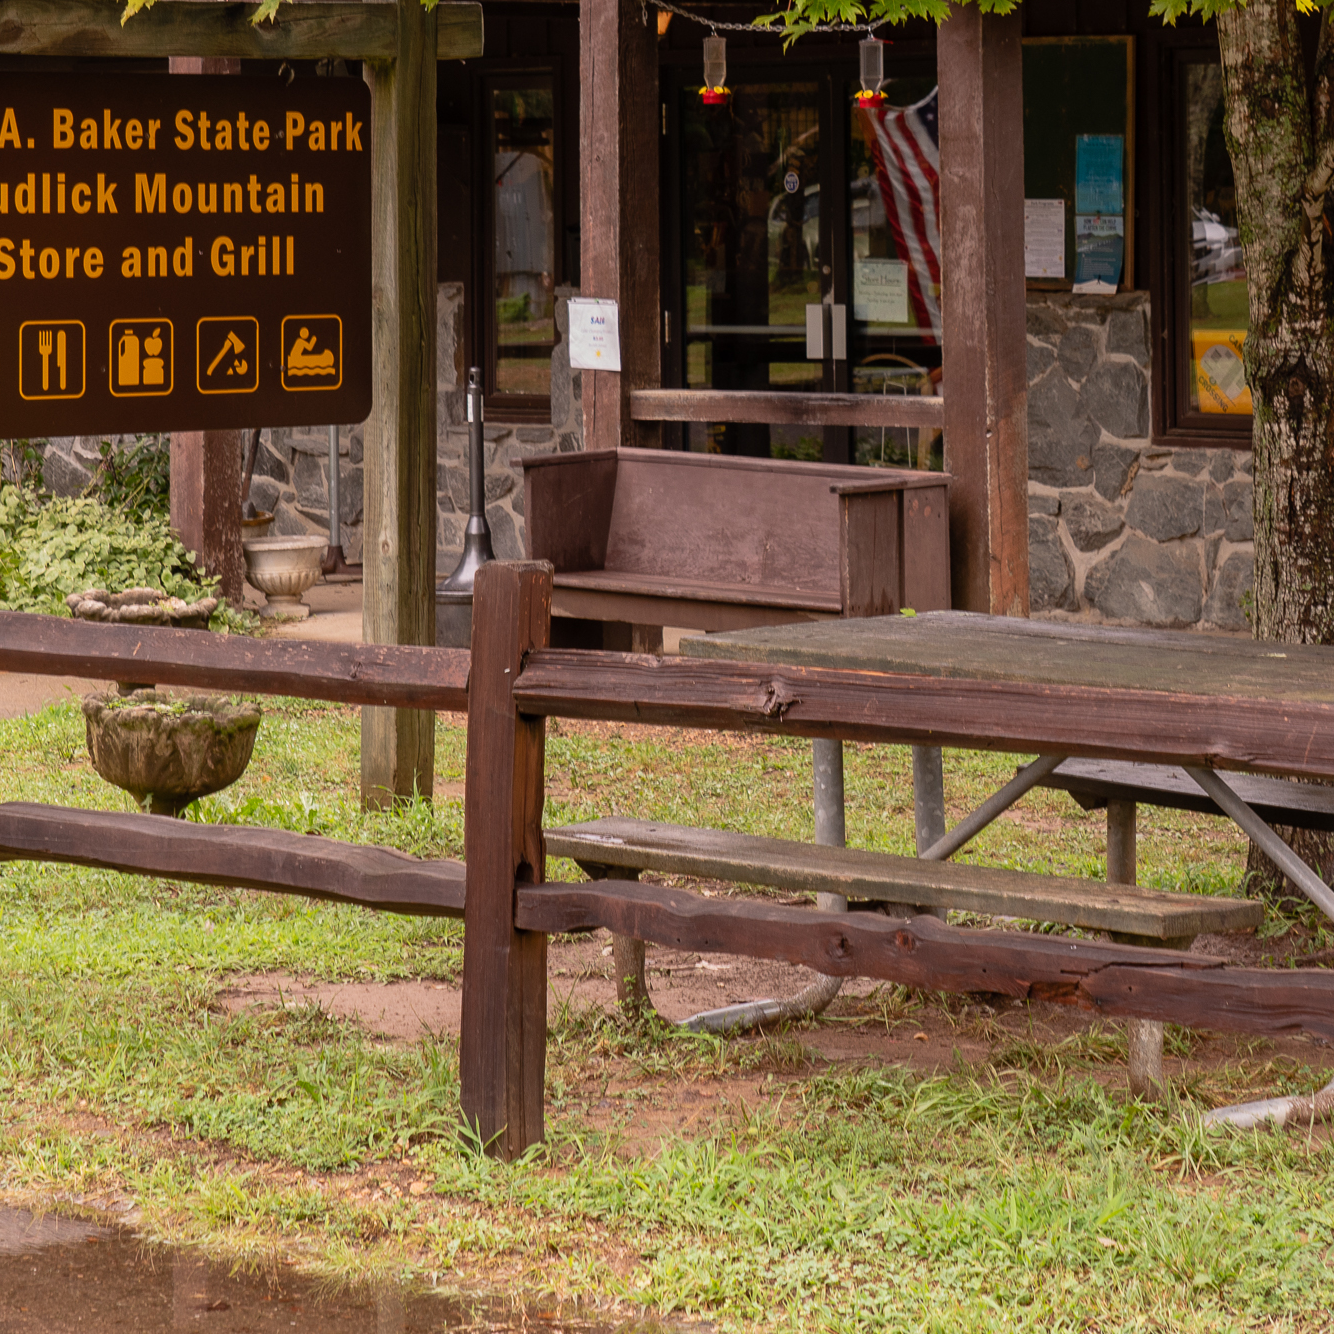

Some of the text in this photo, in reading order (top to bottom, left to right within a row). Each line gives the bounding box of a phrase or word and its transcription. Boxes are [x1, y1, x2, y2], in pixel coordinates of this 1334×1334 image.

[54, 109, 161, 150] Baker
[175, 110, 270, 151] State
[286, 112, 363, 151] Park
[136, 173, 324, 214] Mountain
[121, 237, 193, 278] and
[211, 236, 295, 277] Grill
[1198, 376, 1229, 413] CROSSING
